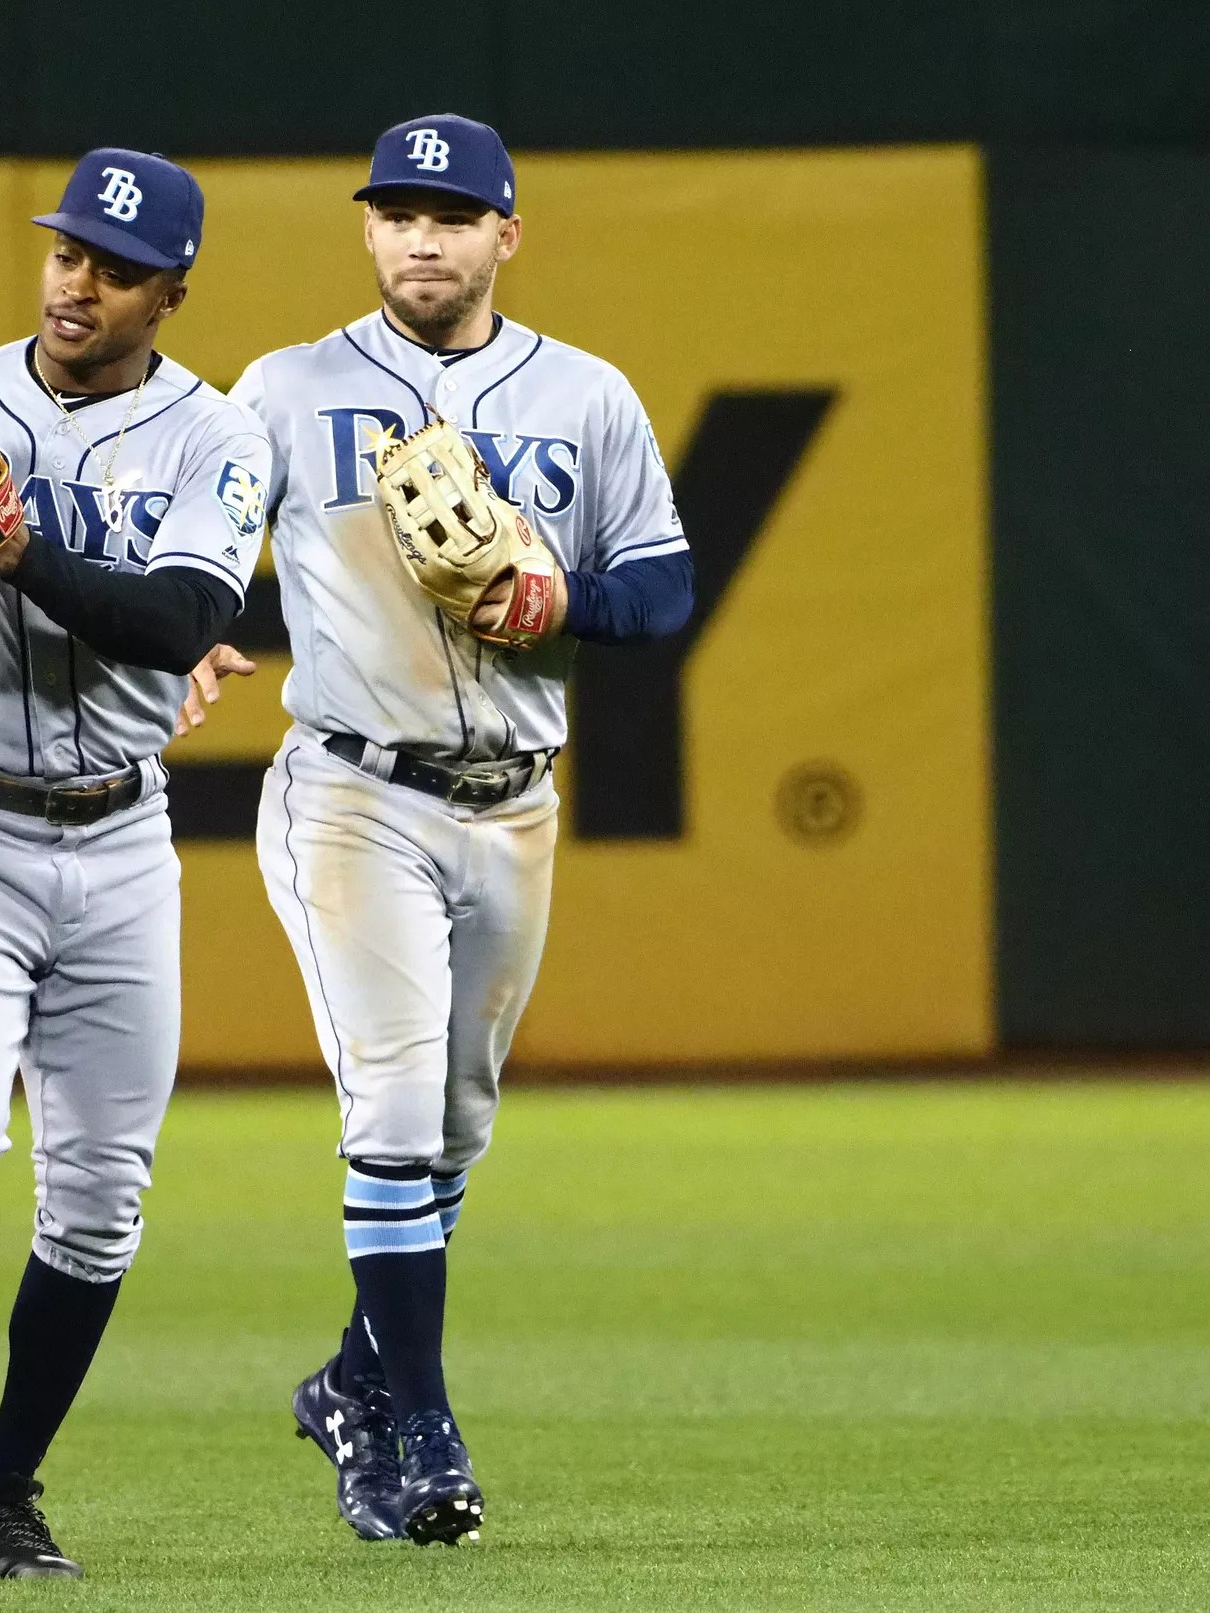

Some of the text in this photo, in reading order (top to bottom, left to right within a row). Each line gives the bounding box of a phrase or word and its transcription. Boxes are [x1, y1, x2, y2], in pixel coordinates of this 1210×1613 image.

[405, 129, 450, 172] TB
[97, 167, 143, 222] TB
[314, 405, 583, 516] RYS
